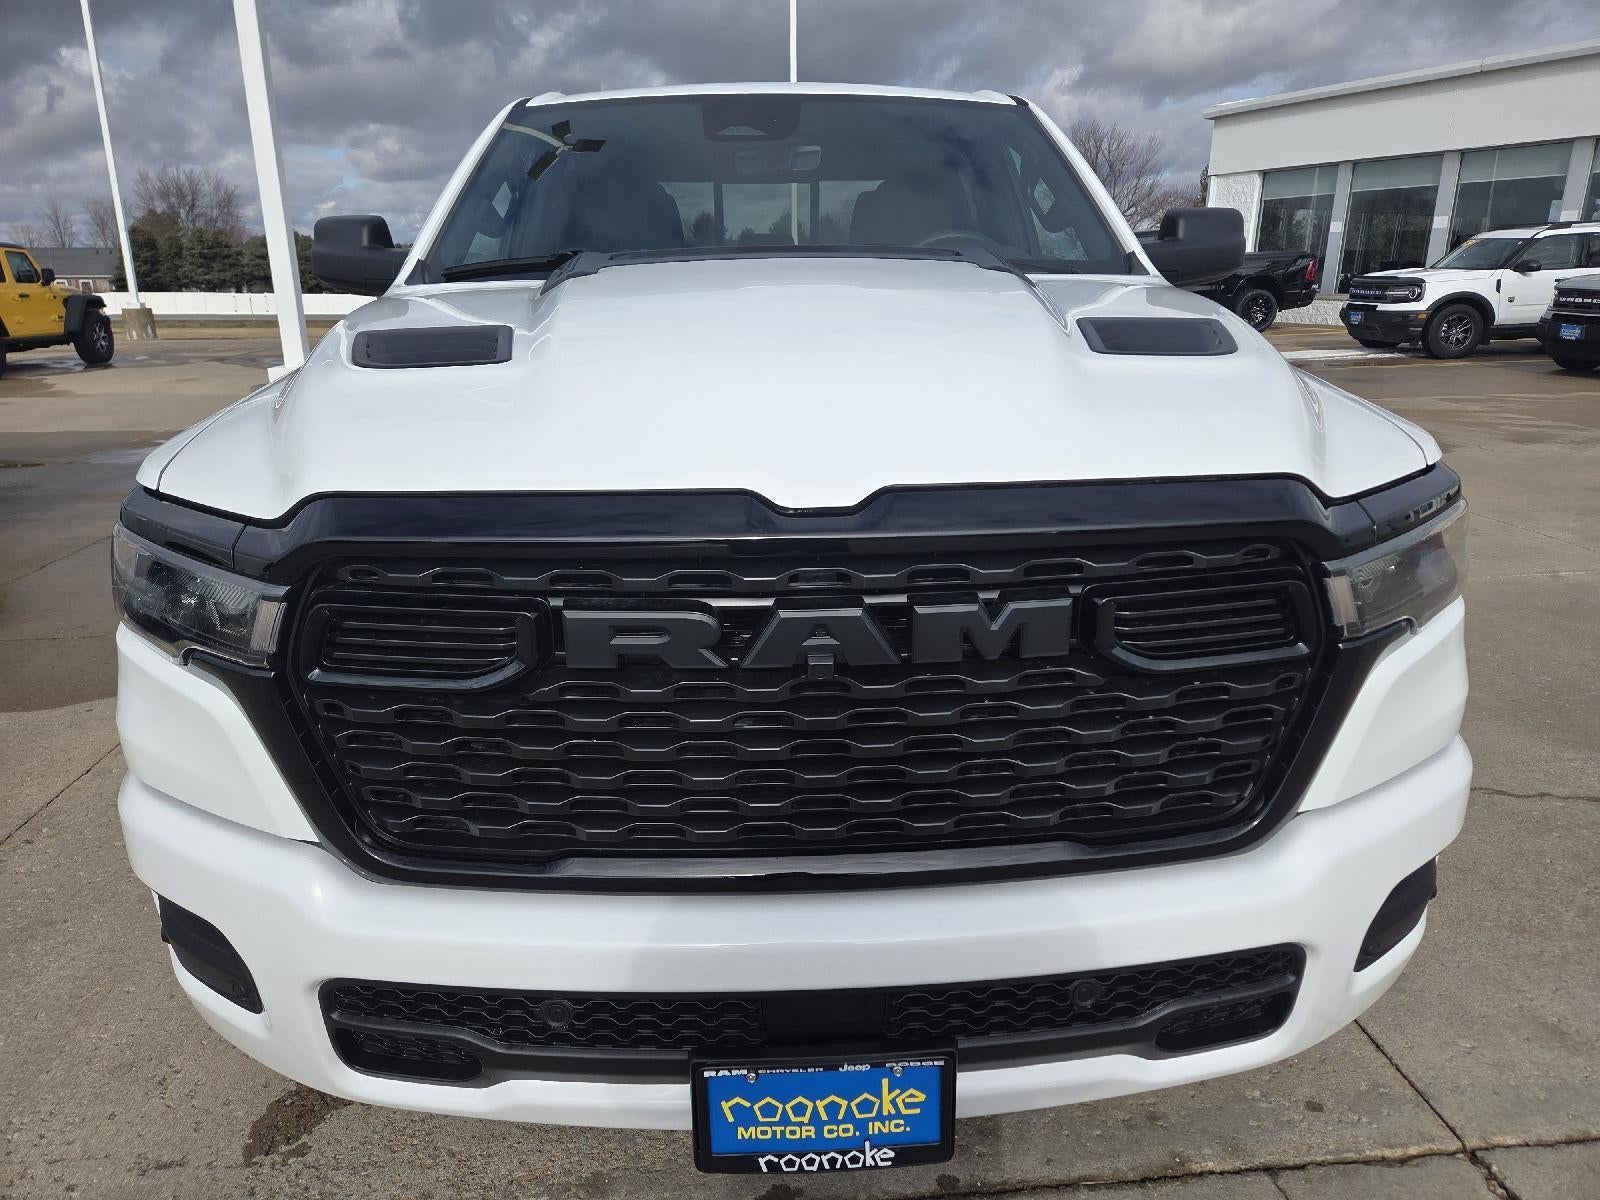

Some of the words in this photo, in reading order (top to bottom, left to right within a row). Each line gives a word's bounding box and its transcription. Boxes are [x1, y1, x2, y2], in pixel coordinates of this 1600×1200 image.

[561, 597, 1074, 669] RAM
[703, 1069, 748, 1078] RAM
[838, 1063, 871, 1072] Jeep
[720, 1078, 927, 1123] roanoke
[737, 1126, 816, 1140] MOTOR
[823, 1123, 860, 1139] CO.
[868, 1119, 911, 1135] INC.
[758, 1140, 896, 1173] roanoke
